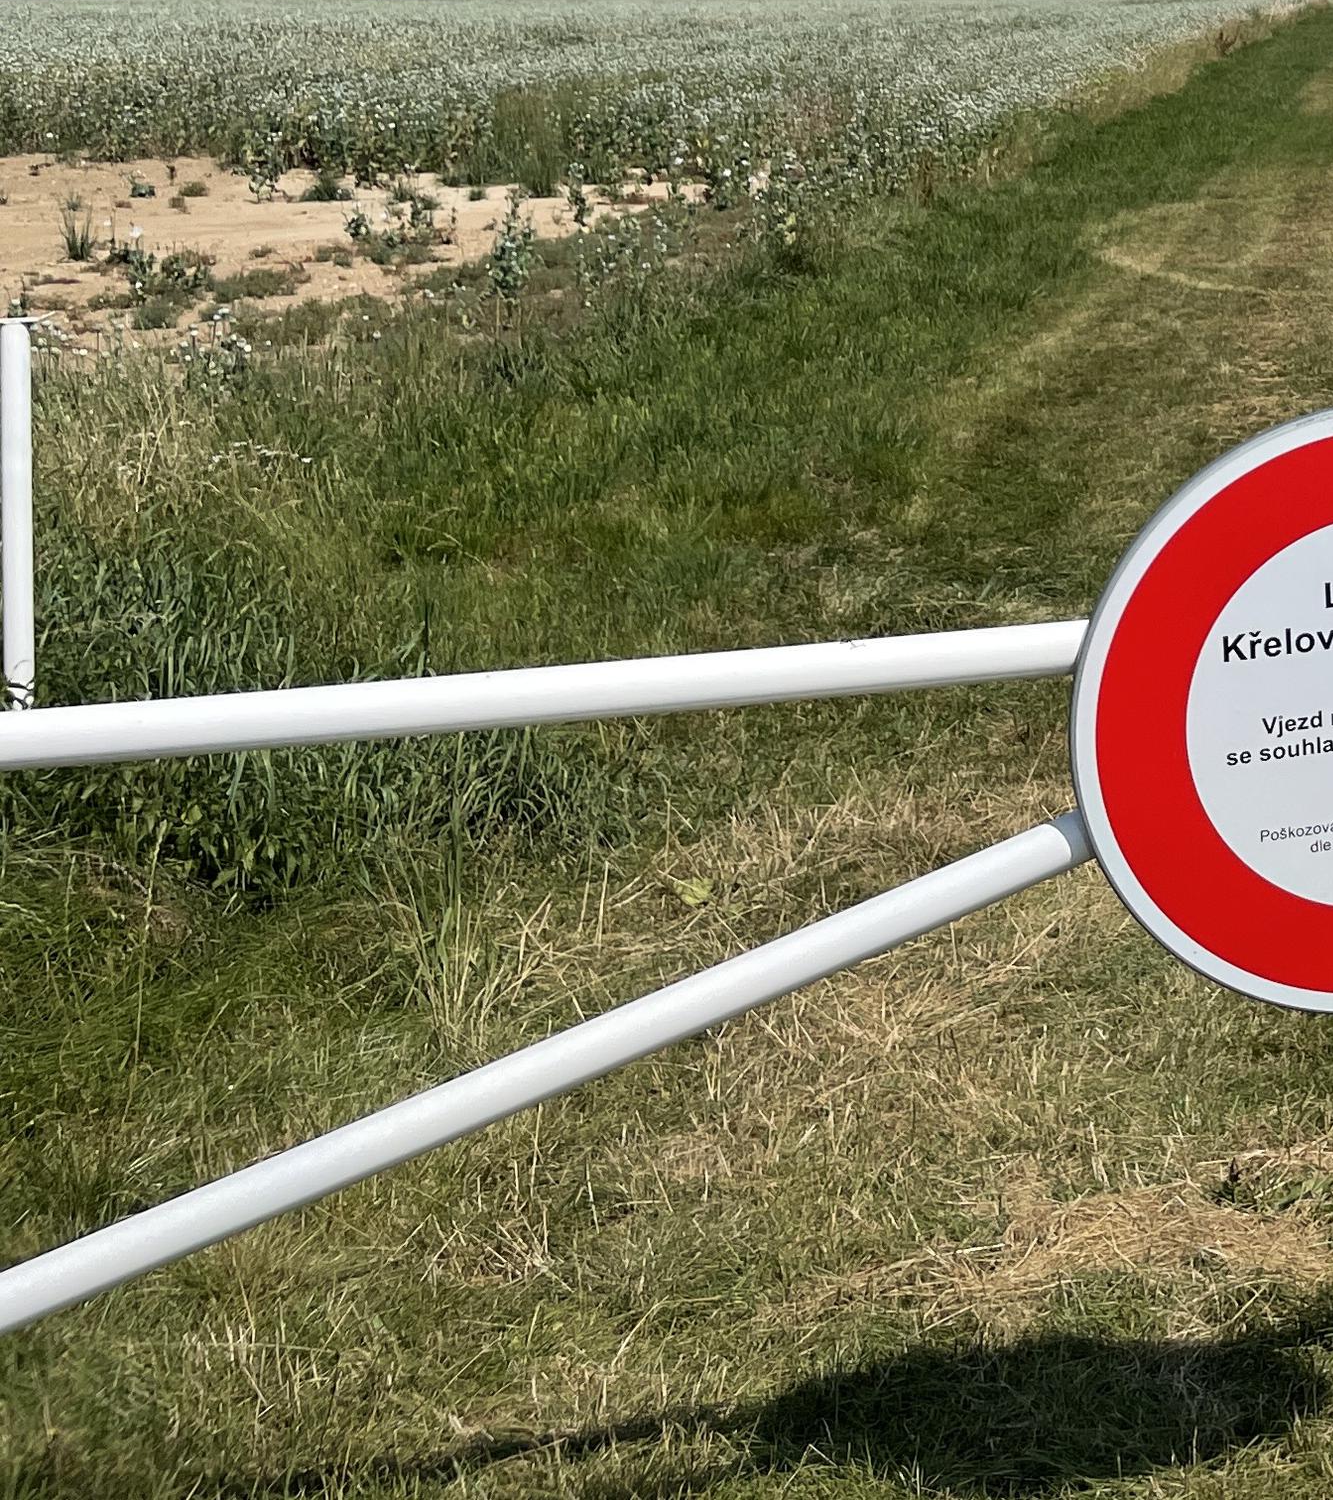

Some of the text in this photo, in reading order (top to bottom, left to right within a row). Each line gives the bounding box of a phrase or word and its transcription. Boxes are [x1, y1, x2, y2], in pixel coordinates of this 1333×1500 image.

[1262, 710, 1323, 738] Vjezd
[1227, 751, 1251, 766] se
[1310, 839, 1331, 853] dle
